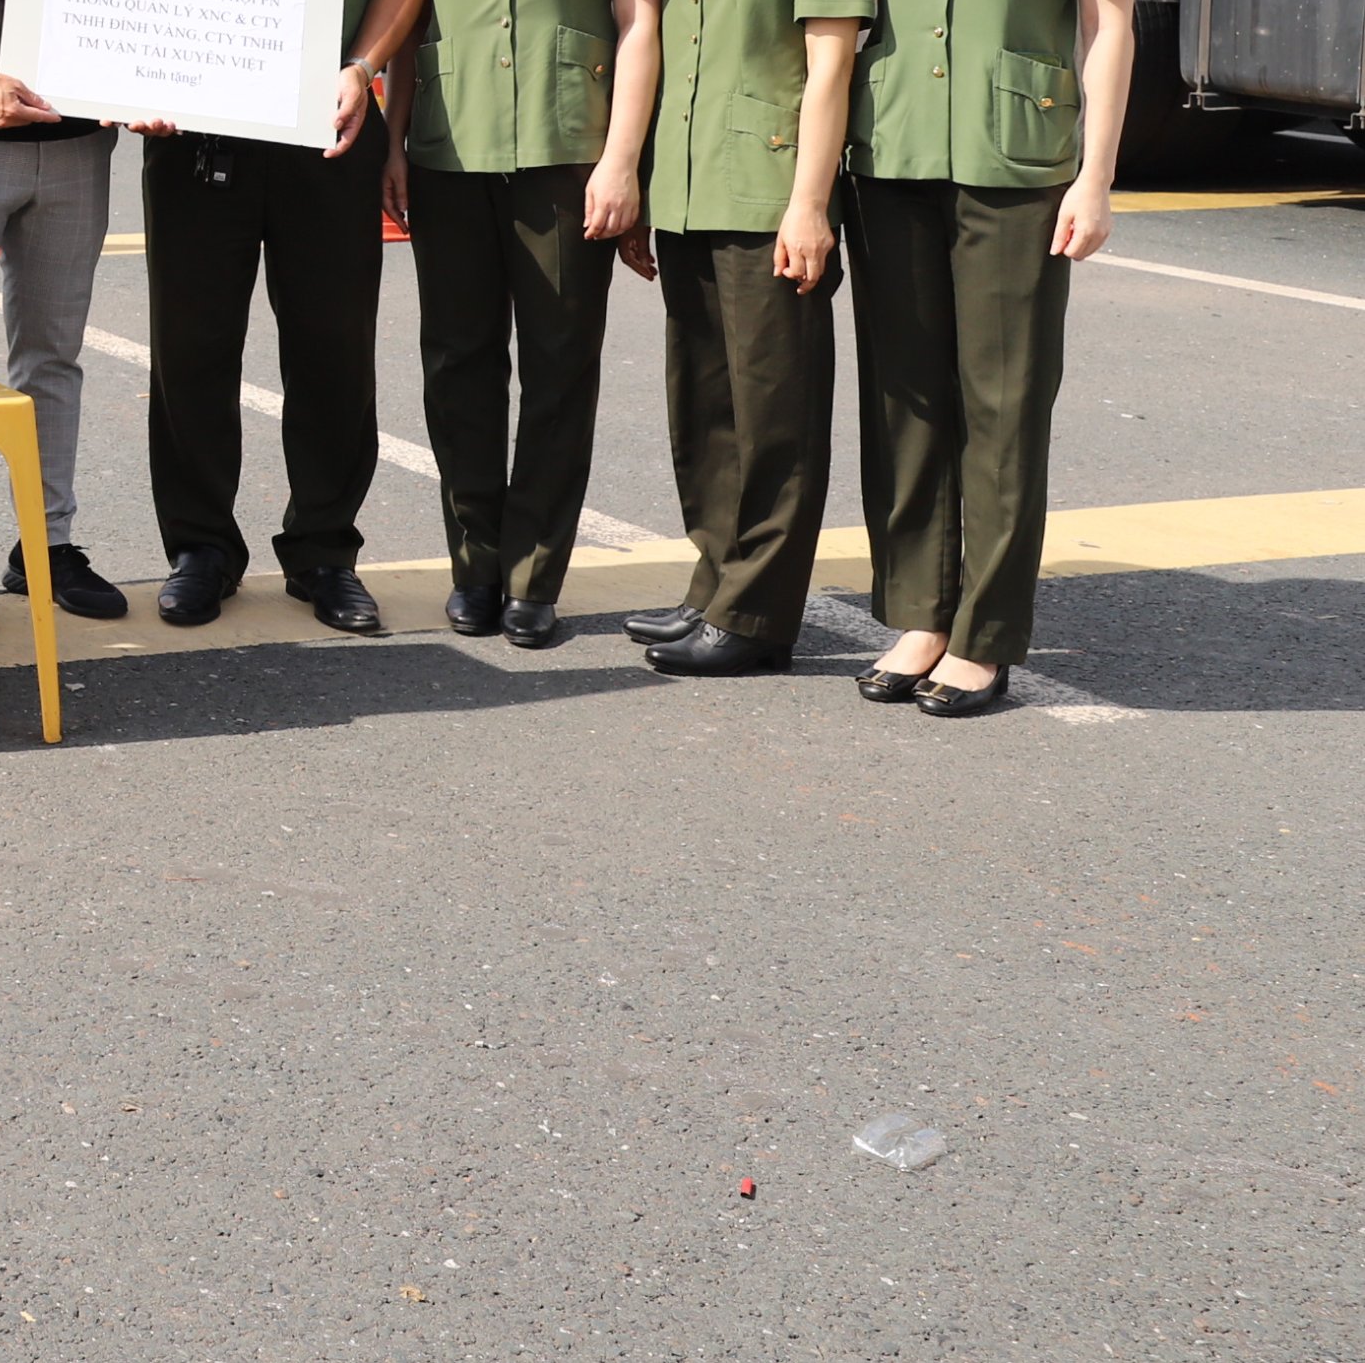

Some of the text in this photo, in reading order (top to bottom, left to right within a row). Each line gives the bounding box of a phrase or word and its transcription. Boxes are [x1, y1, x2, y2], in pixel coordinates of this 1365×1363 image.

[62, 11, 105, 28] TNHH
[204, 30, 236, 45] CTY
[240, 35, 284, 52] TNHH
[173, 3, 194, 18] LÝ
[197, 7, 231, 23] XNC
[234, 13, 246, 25] &
[250, 14, 282, 29] CTY
[76, 35, 99, 50] TM
[104, 38, 137, 54] VẬN
[171, 47, 226, 66] XUYÊN
[230, 55, 265, 72] VIỆT
[135, 65, 202, 87] Kính tặng!
